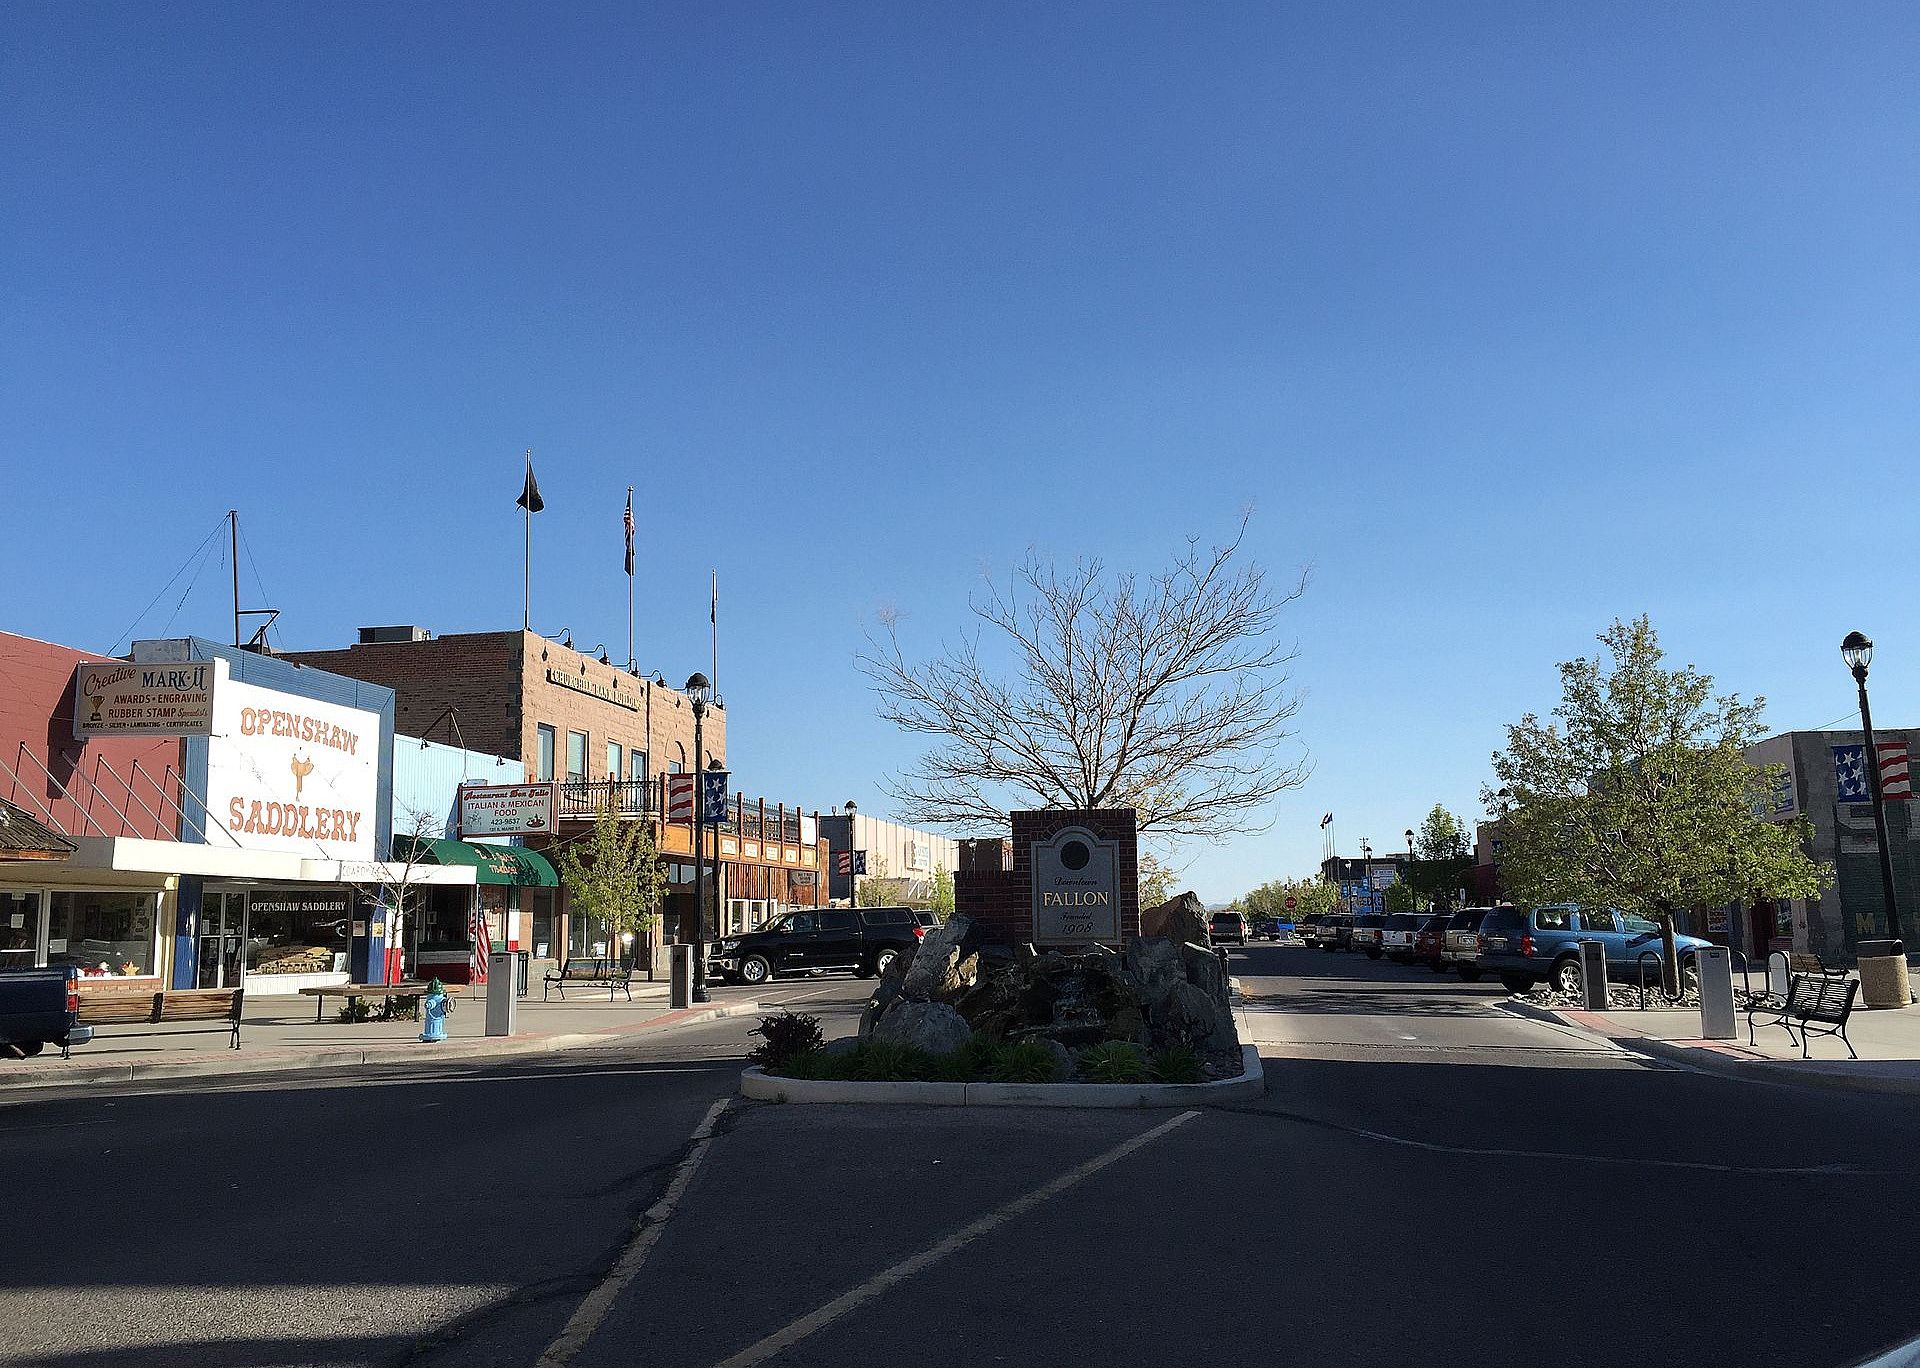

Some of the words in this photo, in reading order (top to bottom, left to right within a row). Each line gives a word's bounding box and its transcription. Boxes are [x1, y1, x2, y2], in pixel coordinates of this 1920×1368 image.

[84, 667, 137, 697] Creative
[554, 670, 592, 691] CHURCHILL
[113, 694, 151, 704] AWARDS
[158, 693, 208, 703] ENGRAVING
[108, 708, 143, 718] RUBBER
[146, 708, 176, 718] STAMP
[166, 720, 203, 728] CERTIFICATES
[241, 707, 359, 756] OPENSHAW
[464, 791, 508, 801] Restaurant
[467, 801, 498, 810] ITALIAN
[508, 800, 545, 809] MEXICAN
[494, 809, 518, 817] FOOD
[229, 796, 361, 843] SADDLERY
[1054, 877, 1098, 886] Downtown
[1043, 891, 1109, 907] FALLON
[251, 902, 300, 912] OPENSHAW
[301, 901, 347, 911] SADDLERY
[1062, 922, 1094, 934] 1908
